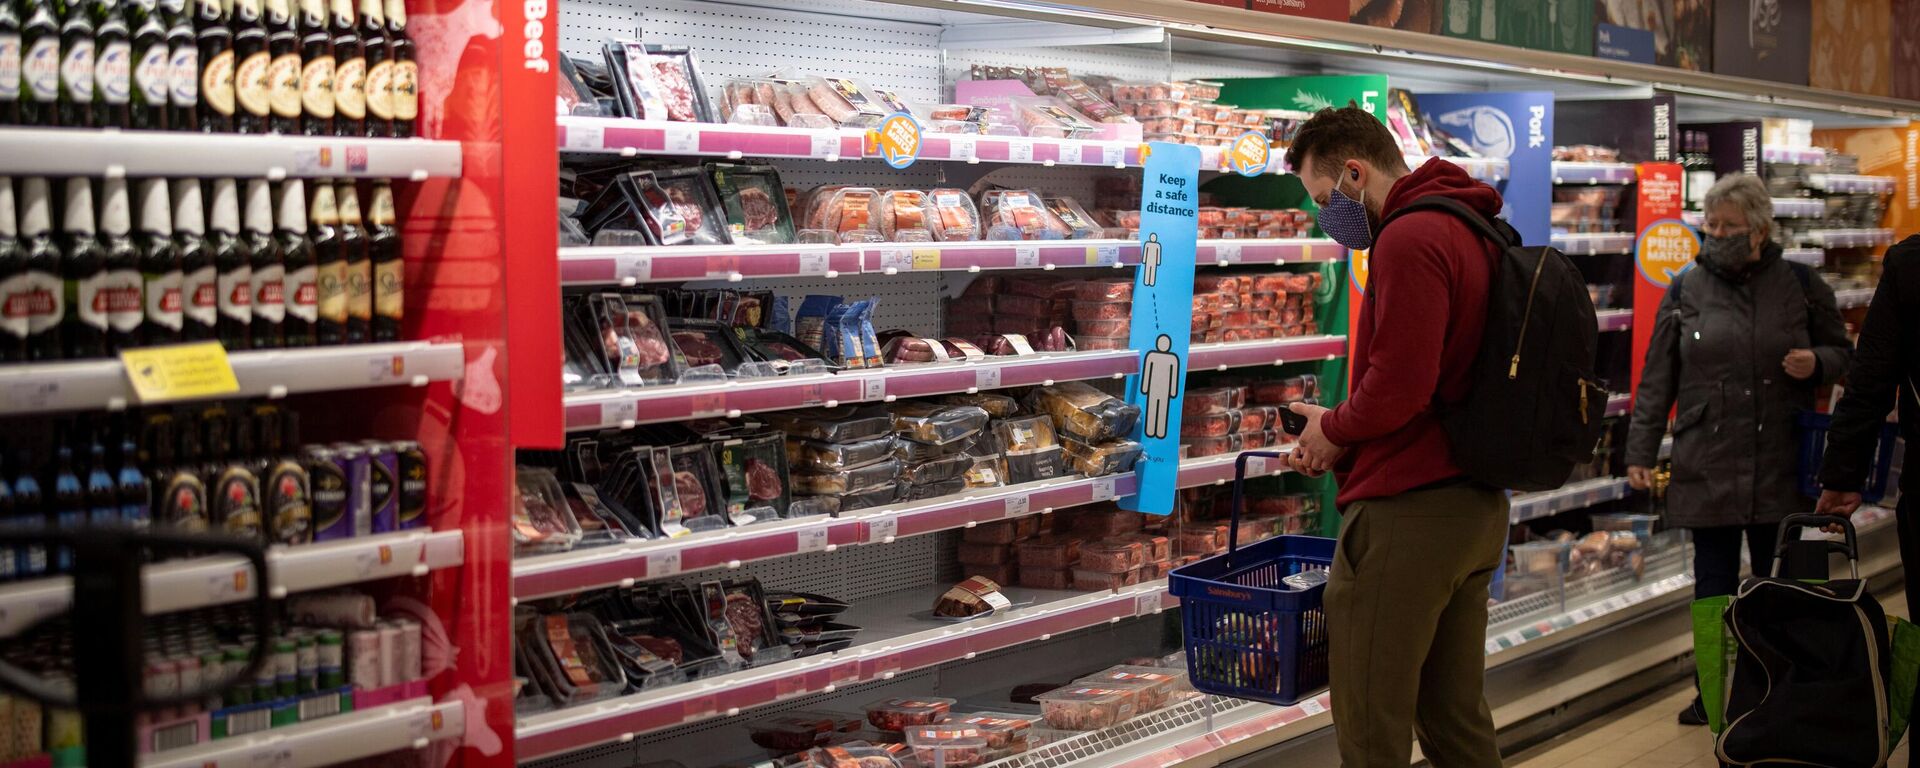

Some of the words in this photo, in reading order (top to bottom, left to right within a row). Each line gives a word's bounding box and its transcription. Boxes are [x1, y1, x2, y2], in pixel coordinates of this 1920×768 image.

[524, 0, 549, 73] Beef
[1363, 91, 1378, 116] La
[1529, 104, 1545, 148] Pork
[1654, 103, 1670, 139] TASTE
[1654, 139, 1670, 161] THE
[1743, 127, 1758, 160] TASTE
[1160, 173, 1186, 188] Keep
[1155, 190, 1162, 199] a
[1165, 190, 1188, 202] safe
[1146, 202, 1194, 218] distance
[1658, 226, 1682, 236] ALDI
[1647, 236, 1692, 250] PRICE
[1647, 249, 1692, 263] MATCH
[1207, 586, 1251, 600] Sainsbury's
